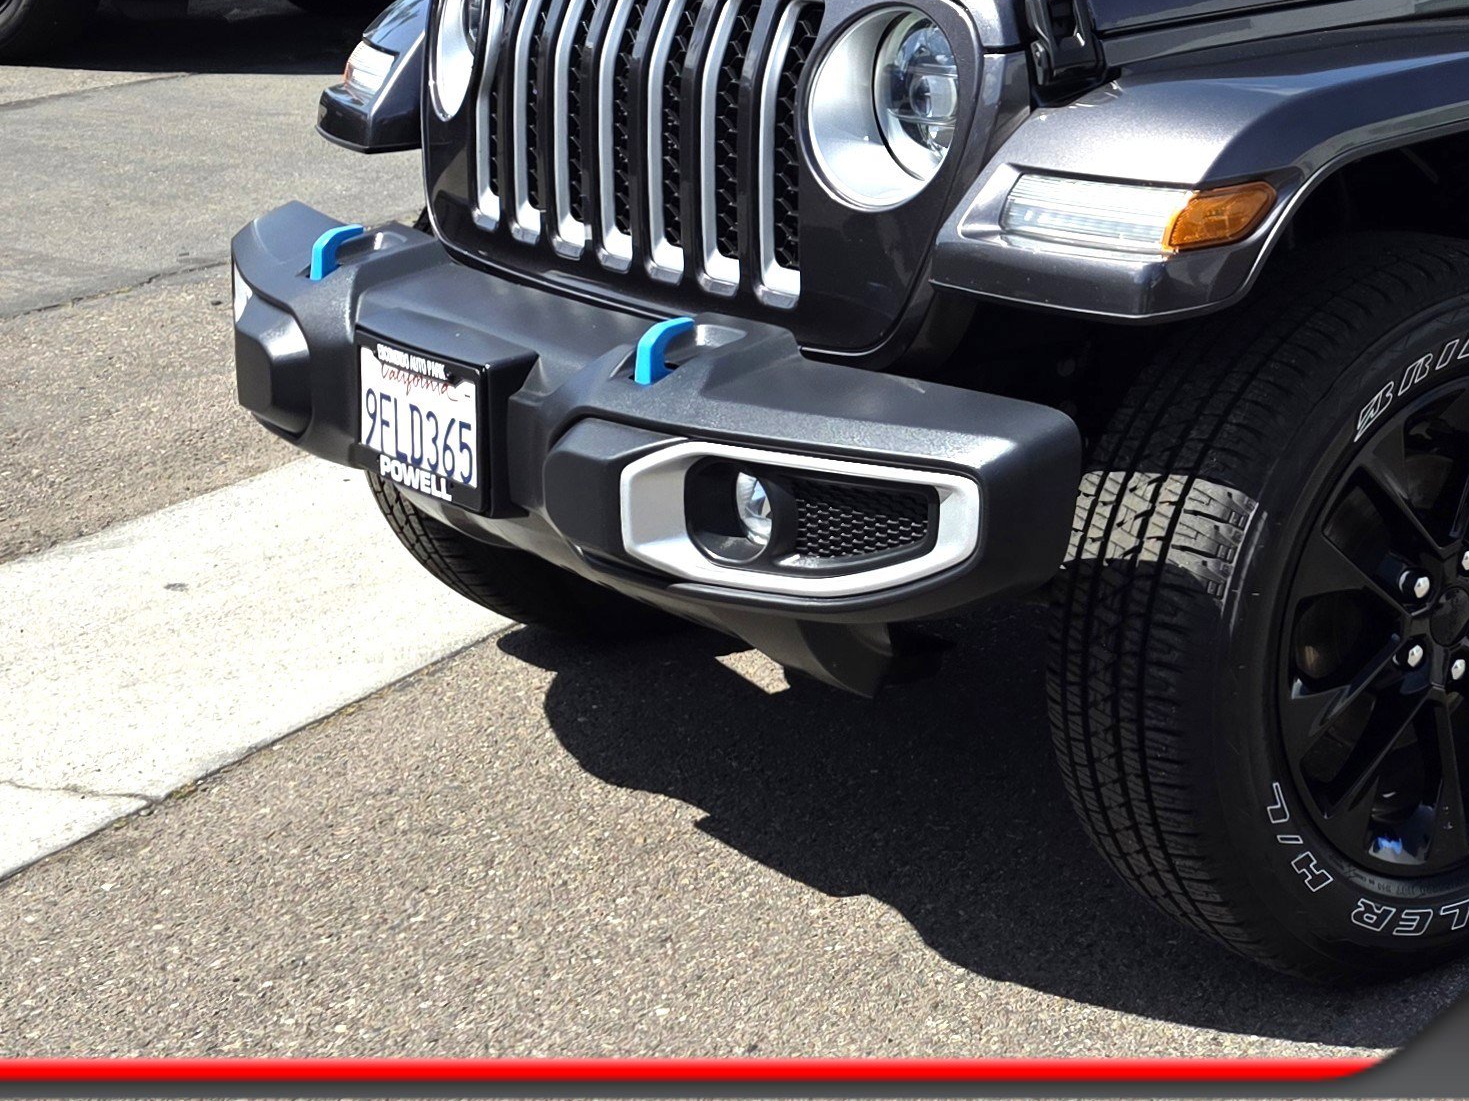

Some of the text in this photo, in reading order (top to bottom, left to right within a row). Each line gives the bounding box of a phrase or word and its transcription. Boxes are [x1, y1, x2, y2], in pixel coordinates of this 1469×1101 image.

[366, 387, 473, 485] 9FLD365
[380, 454, 453, 502] POWELL
[1265, 781, 1334, 893] H/L
